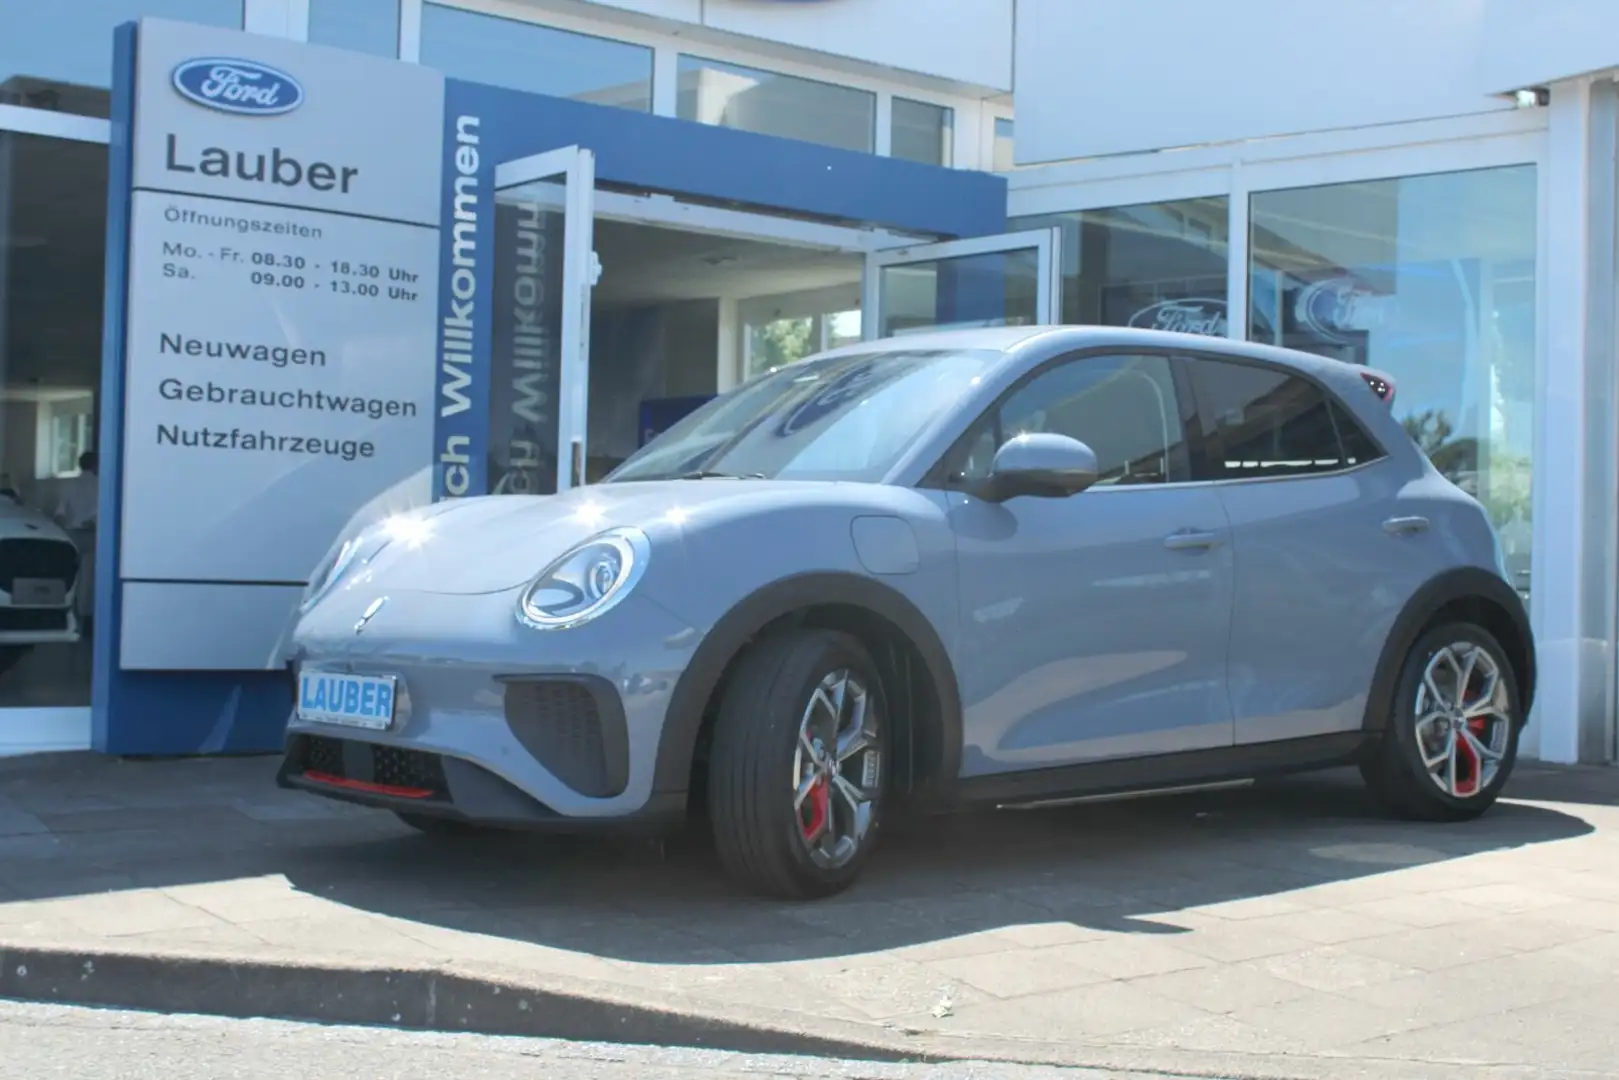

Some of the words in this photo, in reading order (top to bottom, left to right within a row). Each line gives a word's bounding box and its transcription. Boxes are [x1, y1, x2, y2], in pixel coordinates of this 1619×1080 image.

[201, 66, 280, 105] Ford
[166, 133, 358, 194] Lauber
[164, 206, 324, 240] Öffnungszeiten
[162, 263, 196, 279] Sa.
[250, 271, 305, 289] 09.00
[331, 280, 379, 297] 13.00
[388, 286, 418, 302] Uhr
[163, 242, 201, 259] Mo.
[220, 248, 244, 263] Fr.
[251, 251, 306, 270] 08.30
[331, 260, 379, 279] 18.30
[388, 267, 418, 284] Uhr
[441, 115, 480, 417] Willkommen
[160, 332, 326, 368] Neuwagen
[159, 378, 417, 420] Gebrauchtwagen
[156, 424, 375, 461] Nutzfahrzeuge
[440, 435, 470, 500] ch
[302, 677, 392, 717] LAUBER
